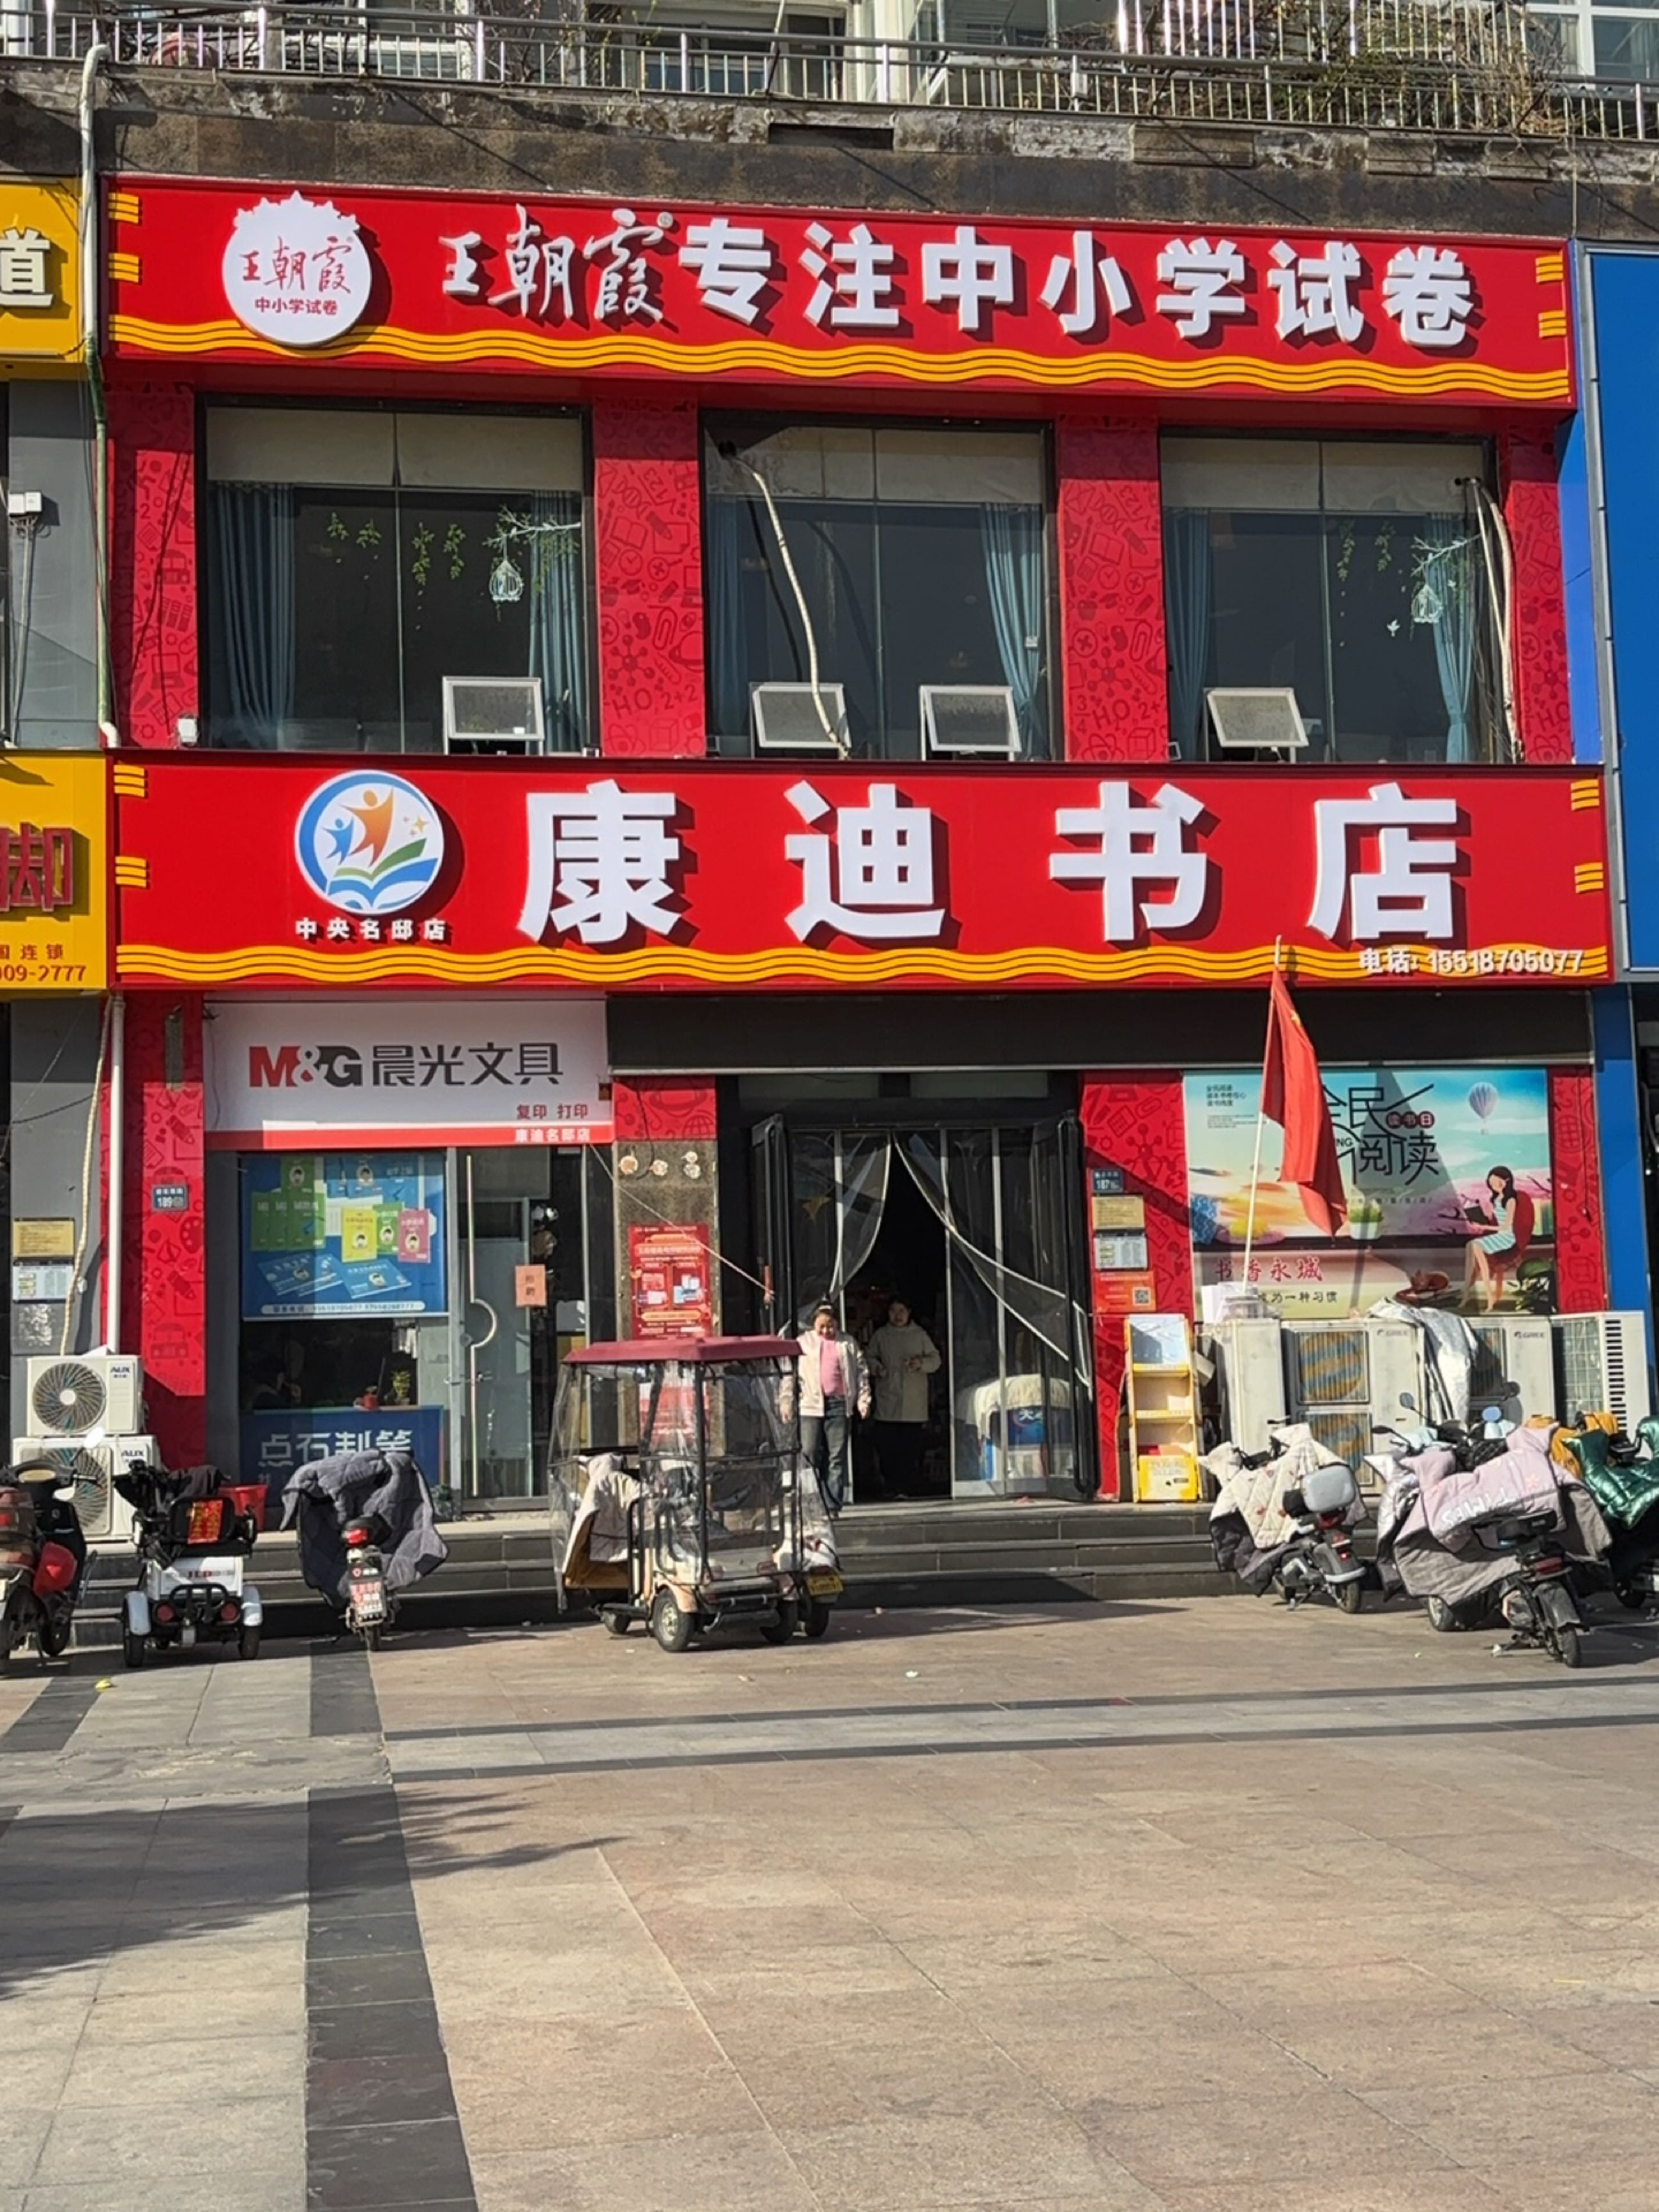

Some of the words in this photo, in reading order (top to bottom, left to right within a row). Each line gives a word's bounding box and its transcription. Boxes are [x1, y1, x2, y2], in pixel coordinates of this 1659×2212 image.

[255, 298, 338, 316] 中小学试卷
[517, 778, 1457, 944] 康迪书店
[295, 917, 446, 940] 中央名邸店
[0, 963, 86, 982] 09-2777
